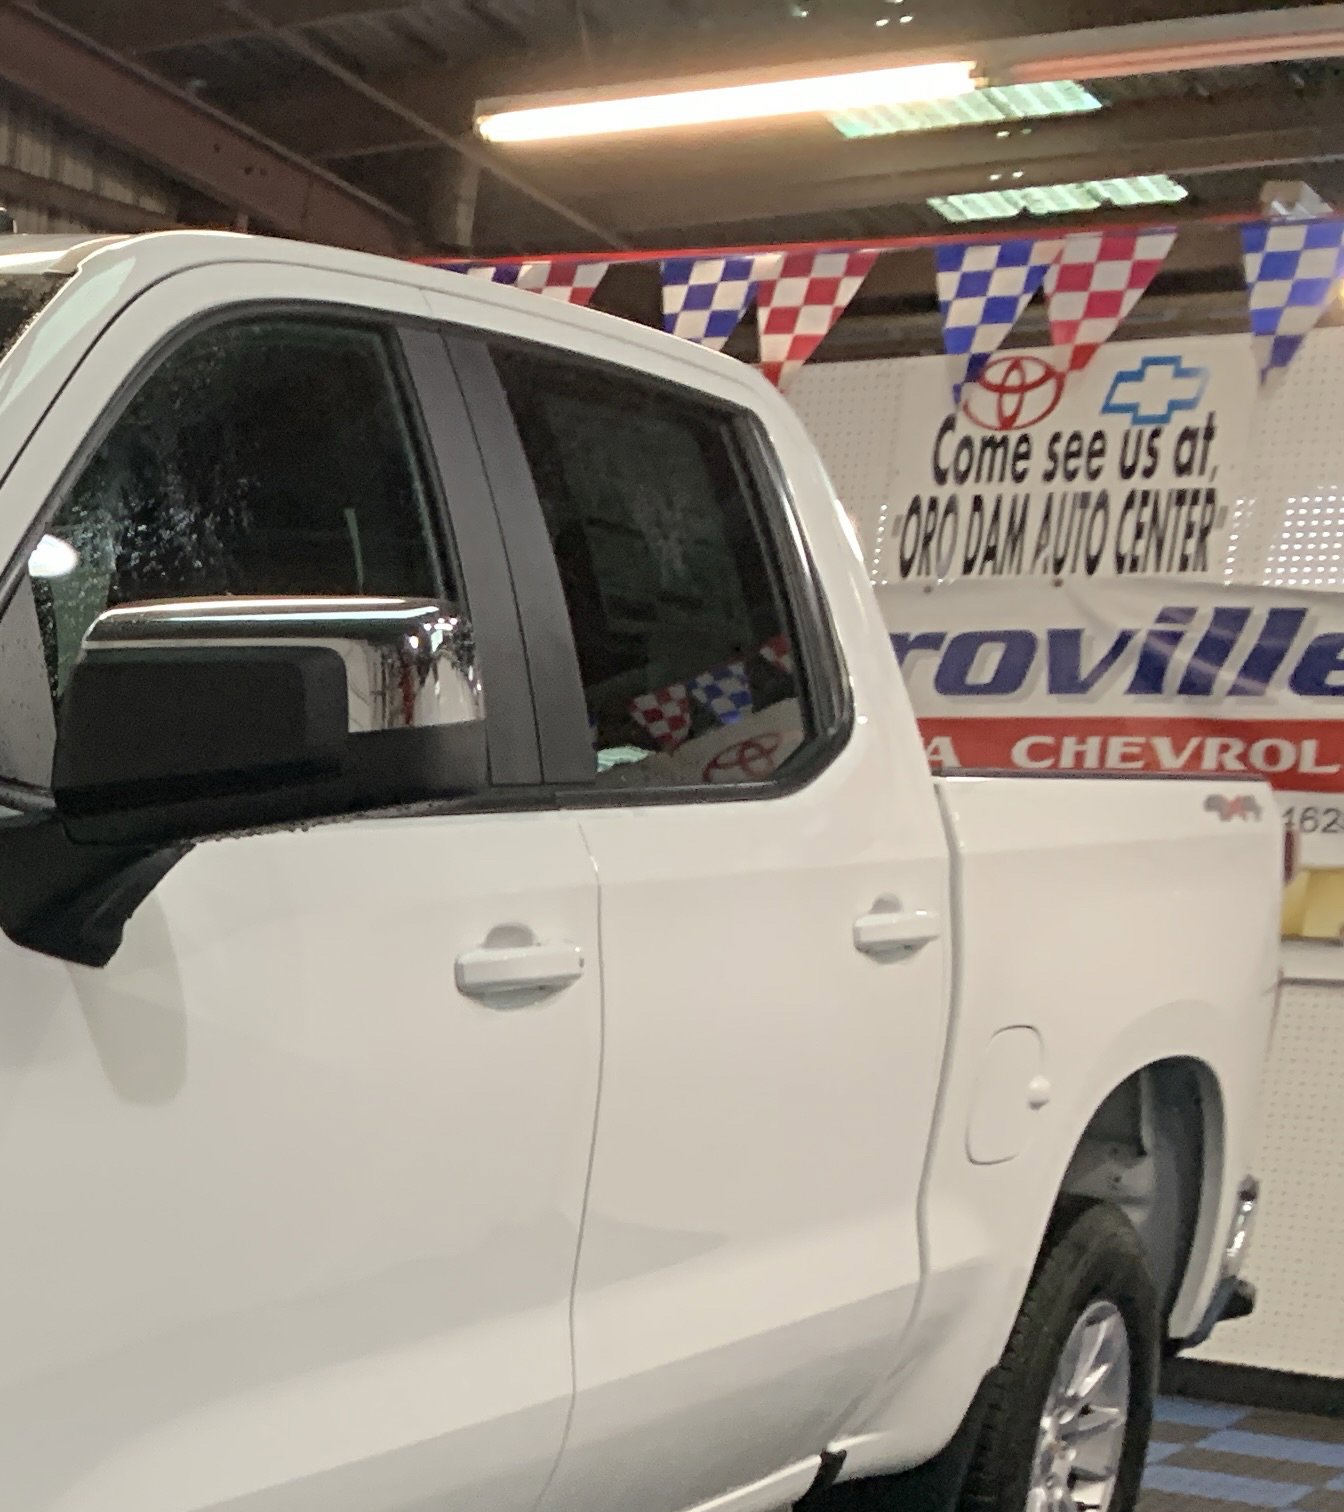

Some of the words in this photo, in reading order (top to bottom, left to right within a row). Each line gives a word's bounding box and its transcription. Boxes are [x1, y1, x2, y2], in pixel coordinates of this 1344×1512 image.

[932, 413, 1032, 485] Come
[1042, 429, 1106, 482] see
[1120, 427, 1162, 480] us
[962, 492, 1030, 575] DAM
[1031, 489, 1110, 576] AUTO
